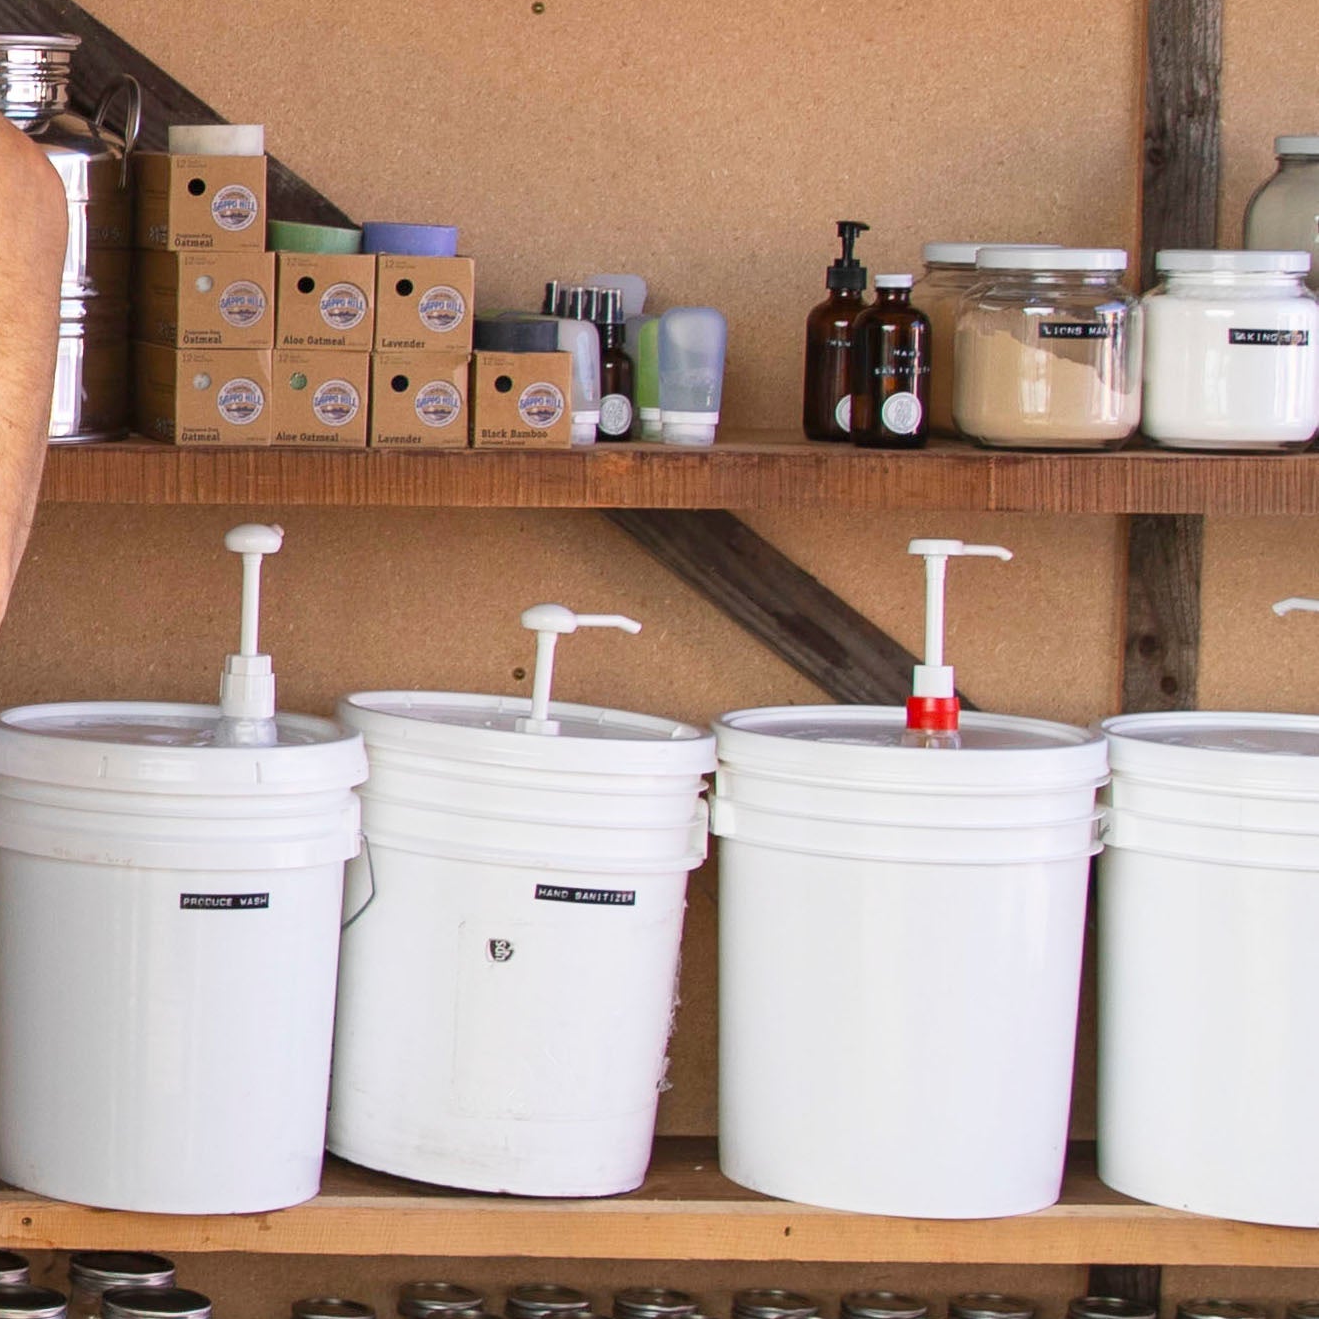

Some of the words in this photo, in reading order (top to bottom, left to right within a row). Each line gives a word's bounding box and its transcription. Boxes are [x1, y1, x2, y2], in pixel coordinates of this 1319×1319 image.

[174, 237, 214, 247] Oatmeal
[183, 334, 221, 344] Oatmeal
[283, 336, 304, 345] Aloe
[307, 336, 345, 346] Oatmeal
[382, 338, 425, 348] Lavender
[182, 432, 220, 442] Oatmeal
[276, 432, 298, 441] Aloe
[300, 432, 339, 441] Oatmeal
[482, 429, 507, 438] Black
[511, 429, 548, 438] Bamboo
[377, 434, 421, 444] Lavender
[538, 887, 569, 899] HAND
[575, 890, 633, 903] SANITIZER
[183, 897, 233, 906] PRODUCE
[240, 895, 267, 906] WASH
